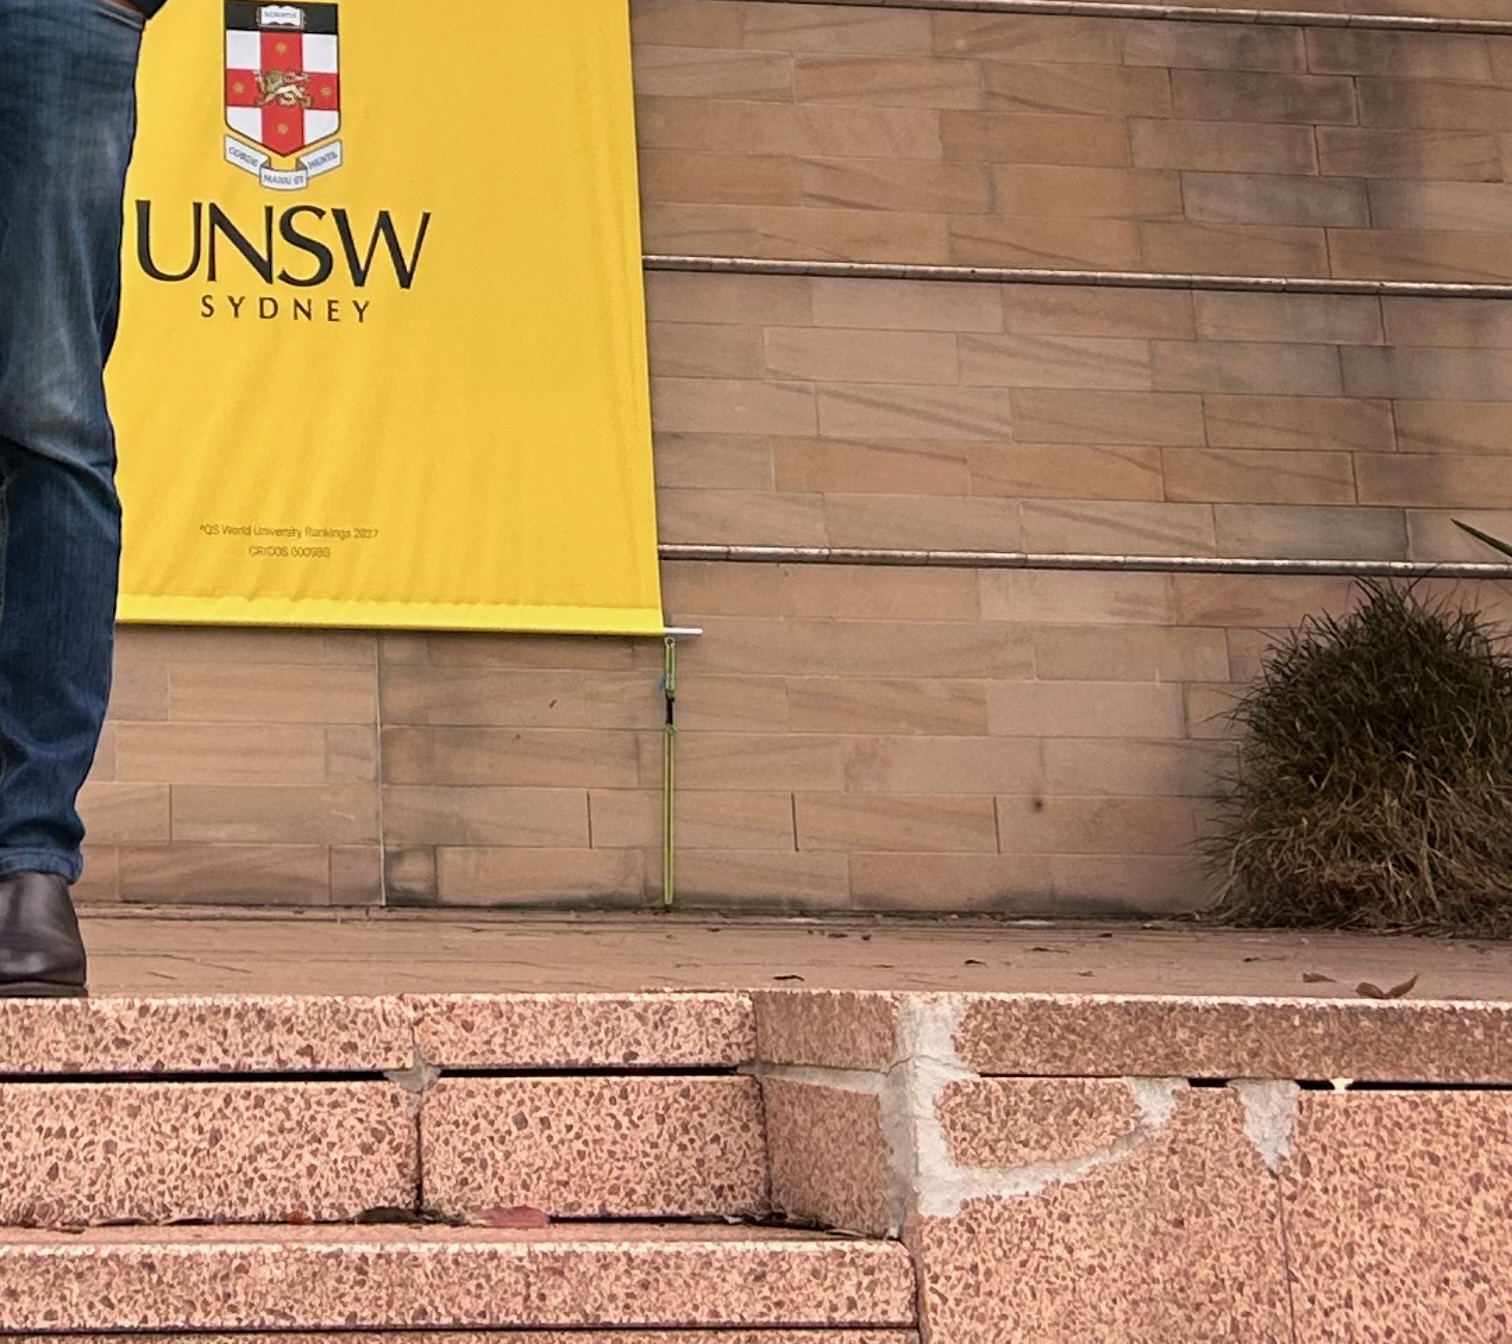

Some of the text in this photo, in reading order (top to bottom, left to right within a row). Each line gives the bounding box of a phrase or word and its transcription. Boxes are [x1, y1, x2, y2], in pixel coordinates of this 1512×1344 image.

[135, 199, 432, 290] UNSW
[200, 294, 371, 324] SYDNEY
[221, 524, 251, 536] World
[253, 525, 302, 539] University
[305, 526, 351, 541] Rankings
